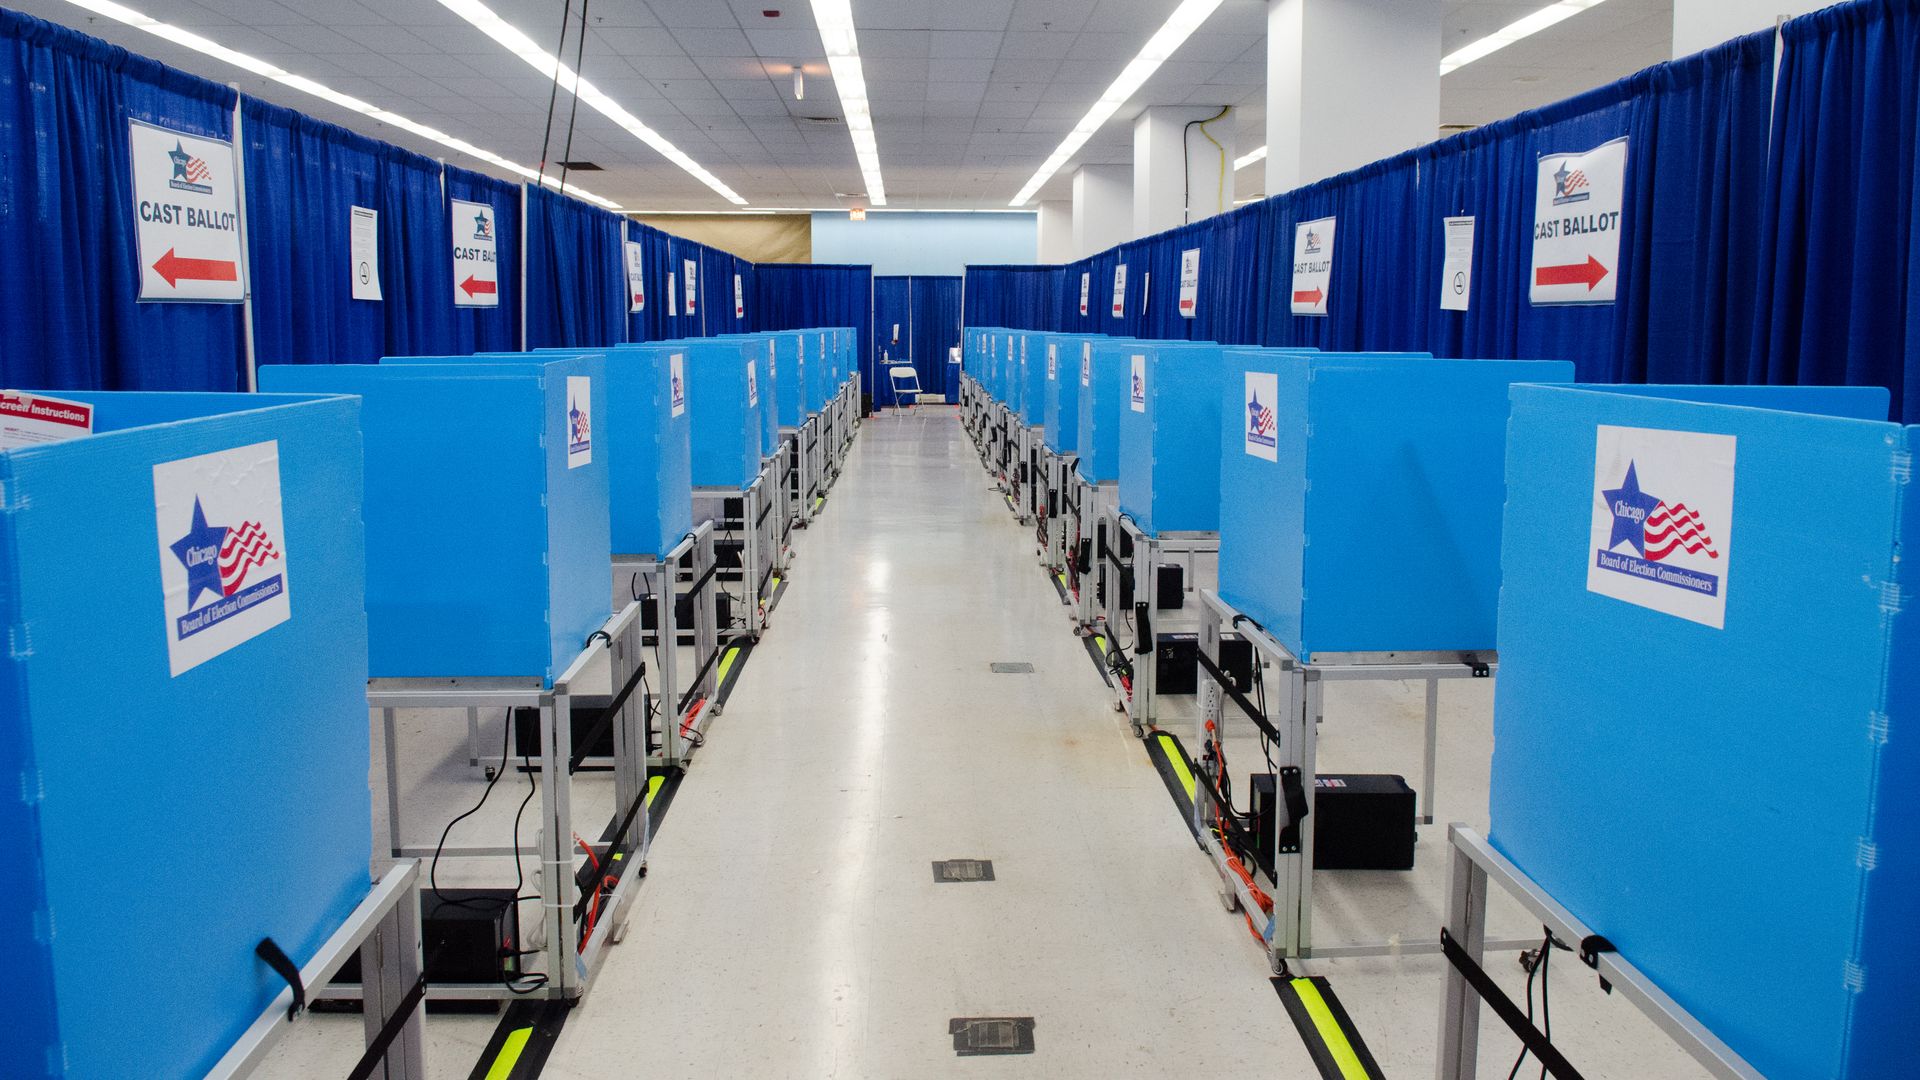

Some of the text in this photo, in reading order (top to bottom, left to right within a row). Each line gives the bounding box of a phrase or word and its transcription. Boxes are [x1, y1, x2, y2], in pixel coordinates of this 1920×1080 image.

[140, 200, 235, 232] CAST BALLOT
[1563, 211, 1619, 236] BALLOT
[454, 246, 480, 261] CAST
[0, 401, 85, 422] creen Instructions
[1615, 500, 1645, 524] Chicago
[186, 545, 217, 567] Chicago
[1600, 553, 1713, 592] Board of Election Commissioners
[181, 582, 280, 636] Board of Election Commissioners
